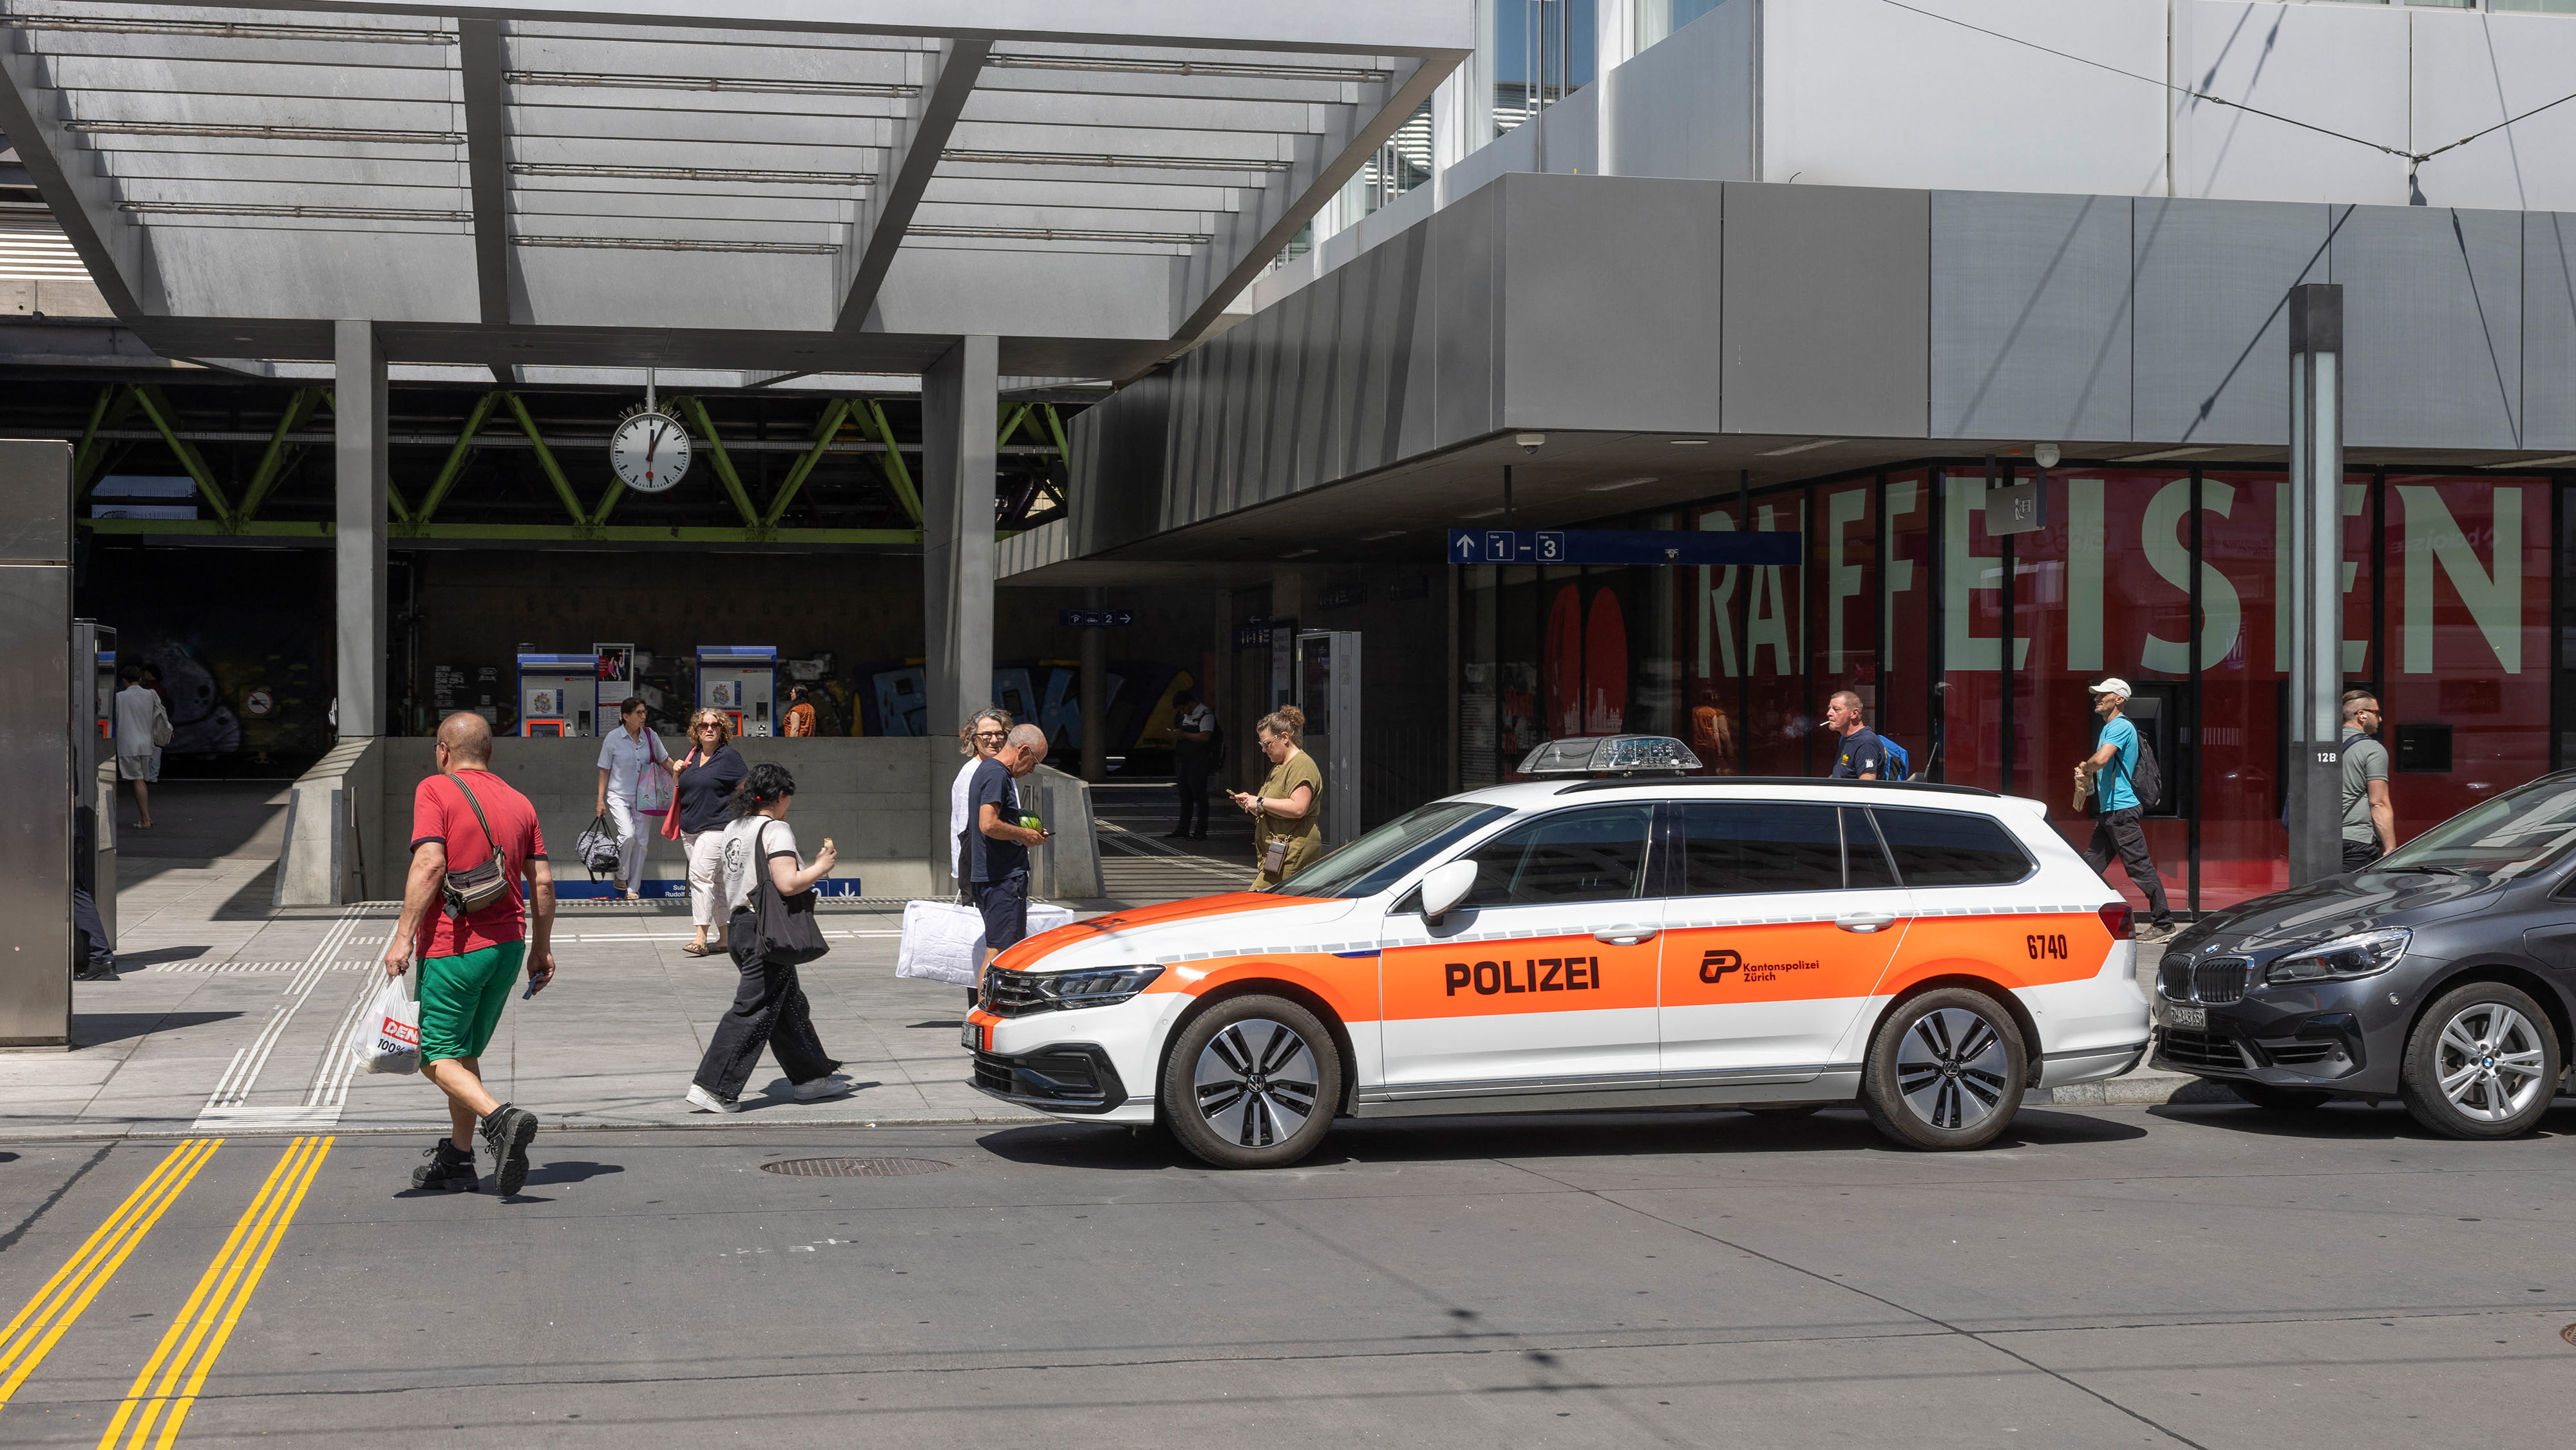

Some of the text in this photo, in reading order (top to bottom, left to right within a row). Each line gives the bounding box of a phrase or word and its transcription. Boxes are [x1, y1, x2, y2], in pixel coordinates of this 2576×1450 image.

[1495, 540, 1504, 557] 1
[1544, 540, 1556, 558] 3
[1105, 614, 1112, 624] 2
[2316, 752, 2336, 763] 12B
[2027, 934, 2068, 960] 6740
[1743, 960, 1819, 973] Kantonspolizei
[1445, 957, 1600, 997] POLIZEI
[1743, 972, 1776, 982] Zürich
[377, 1038, 406, 1056] 100%
